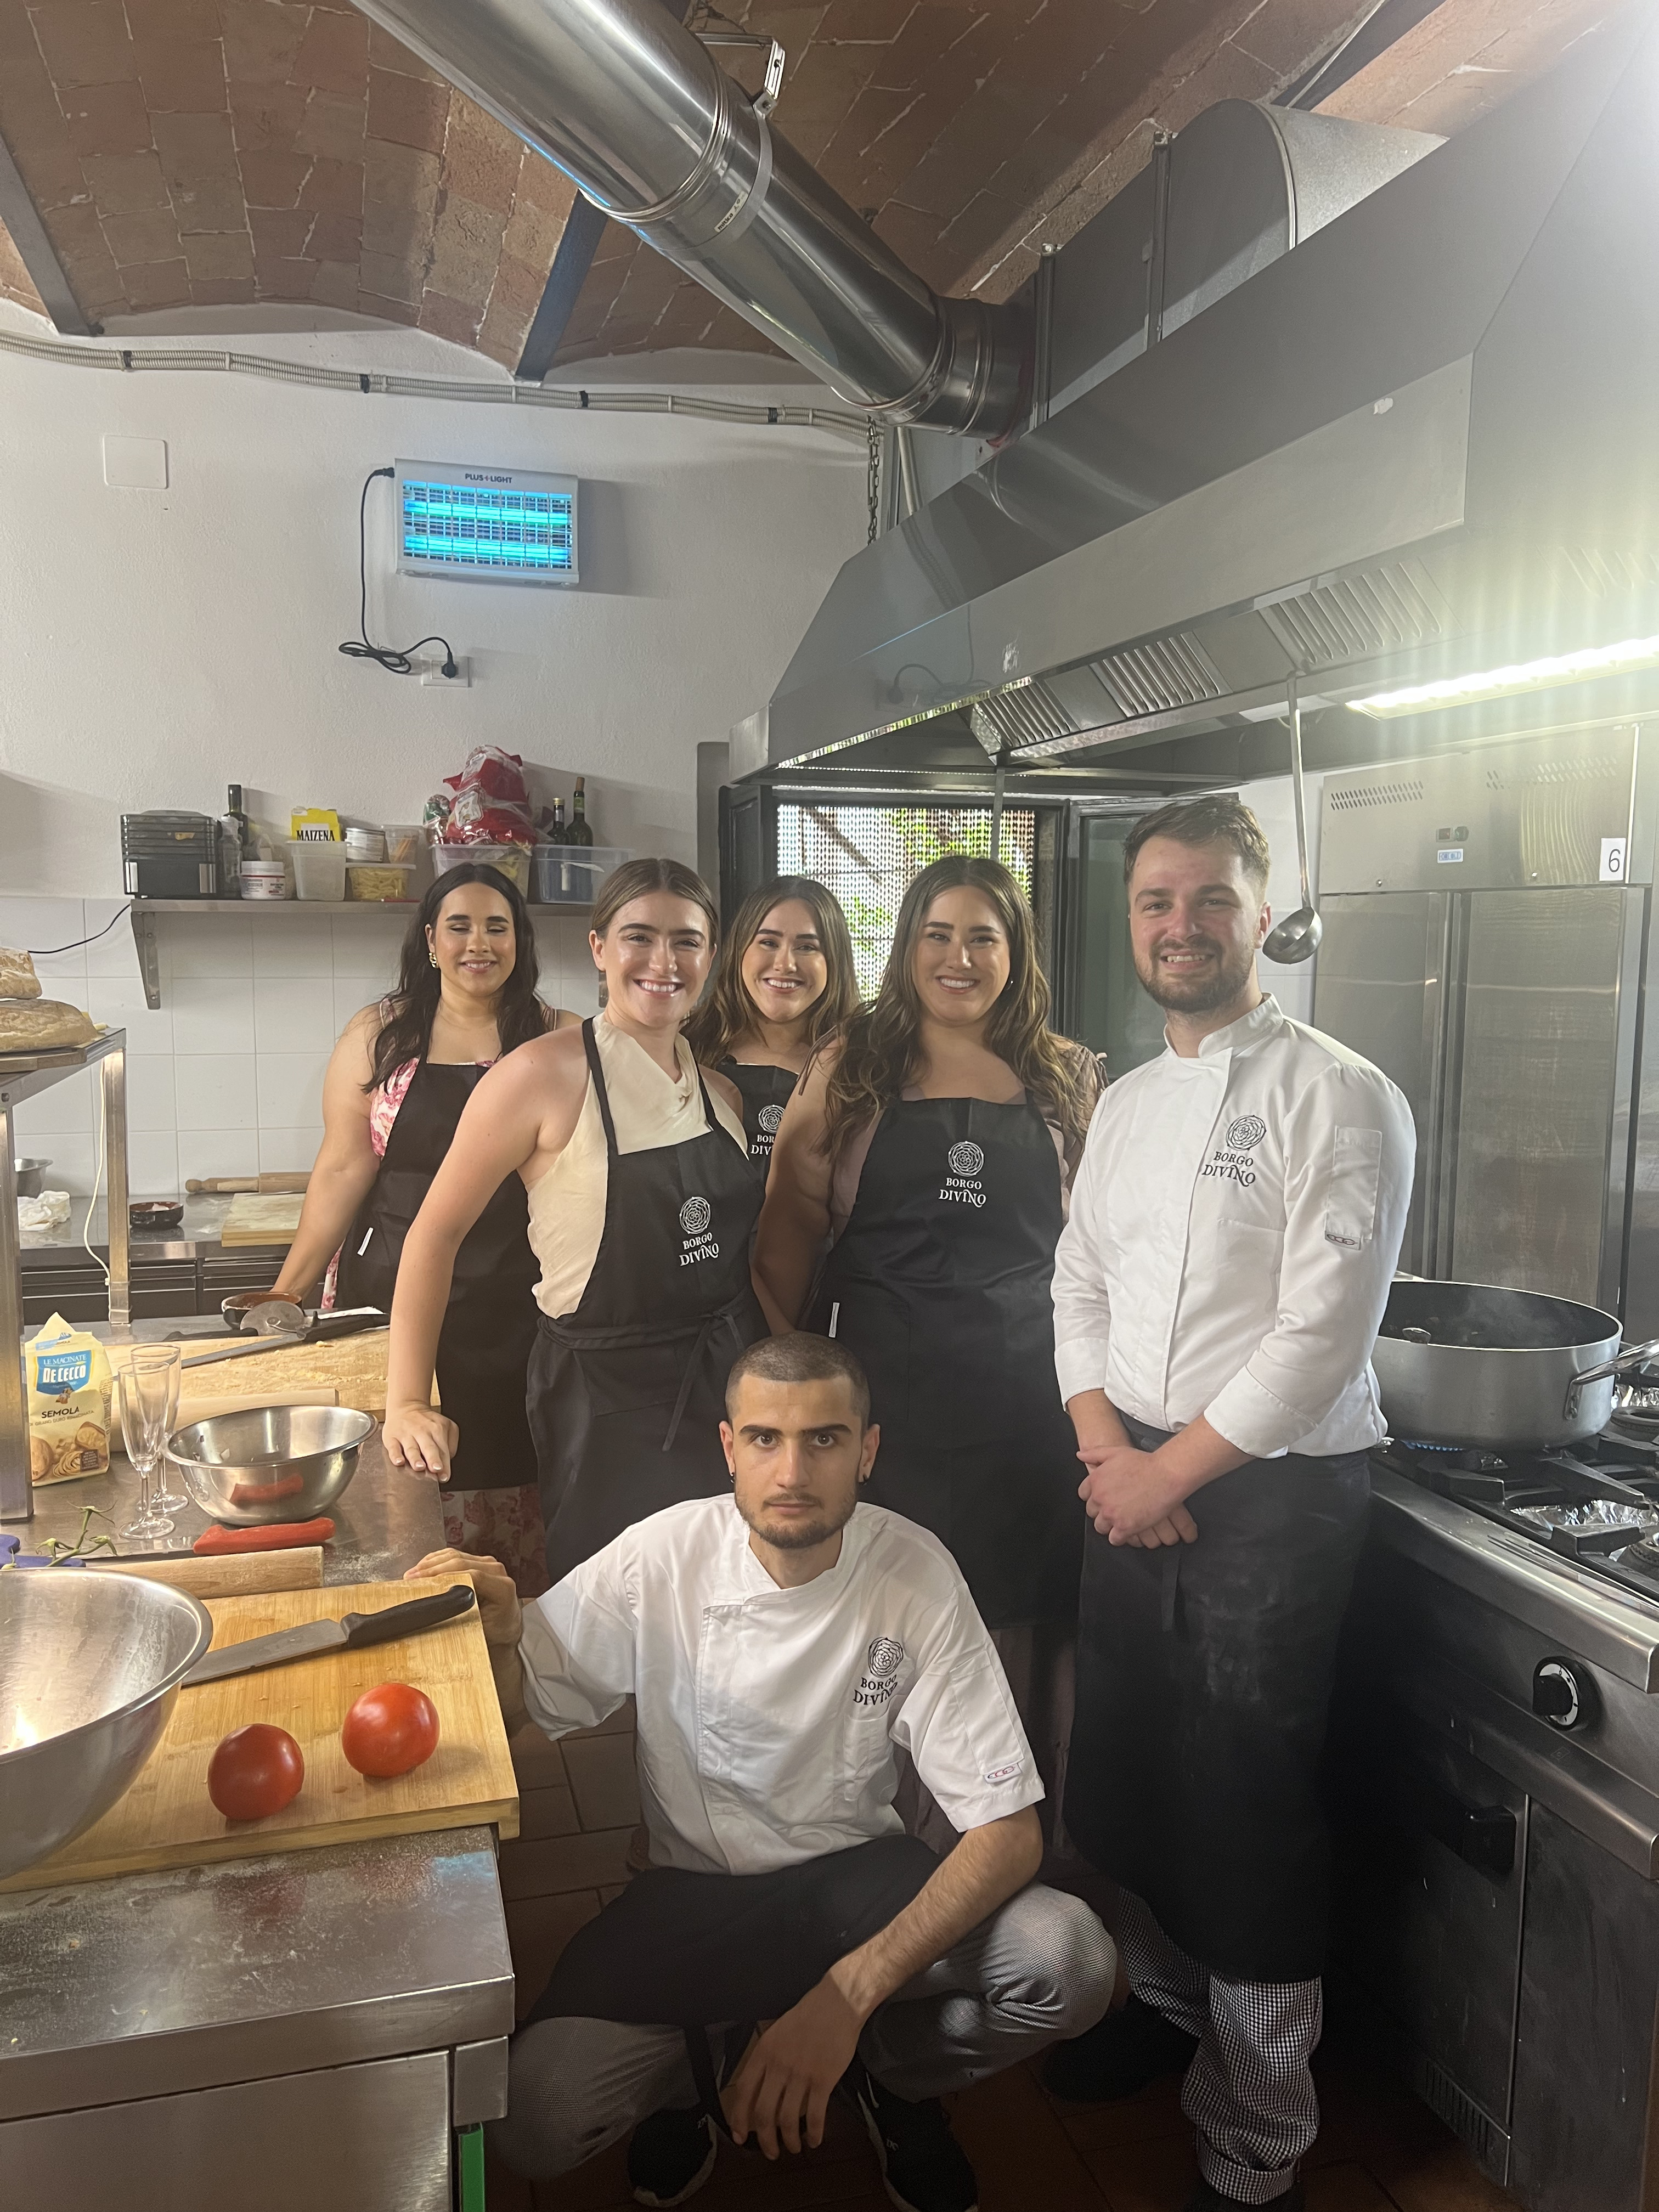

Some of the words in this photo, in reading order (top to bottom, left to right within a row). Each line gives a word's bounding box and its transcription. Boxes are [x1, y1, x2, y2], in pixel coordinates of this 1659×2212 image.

[296, 830, 335, 842] MAIZENA
[1609, 849, 1621, 873] 6
[757, 1135, 774, 1143] BOR
[751, 1145, 771, 1155] DIV
[1214, 1152, 1254, 1166] BORGO
[946, 1177, 982, 1190] BORGO
[1201, 1164, 1256, 1187] DIVINO
[938, 1189, 986, 1208] DIVINO
[682, 1232, 713, 1250] BORGO
[679, 1243, 719, 1266] DIVINO
[53, 1354, 87, 1364] MACINATE
[43, 1368, 57, 1383] DE
[58, 1365, 86, 1382] CECCO
[41, 1406, 80, 1419] SEMOLA
[860, 1674, 897, 1690] BORGO
[853, 1686, 898, 1705] DIVINO
